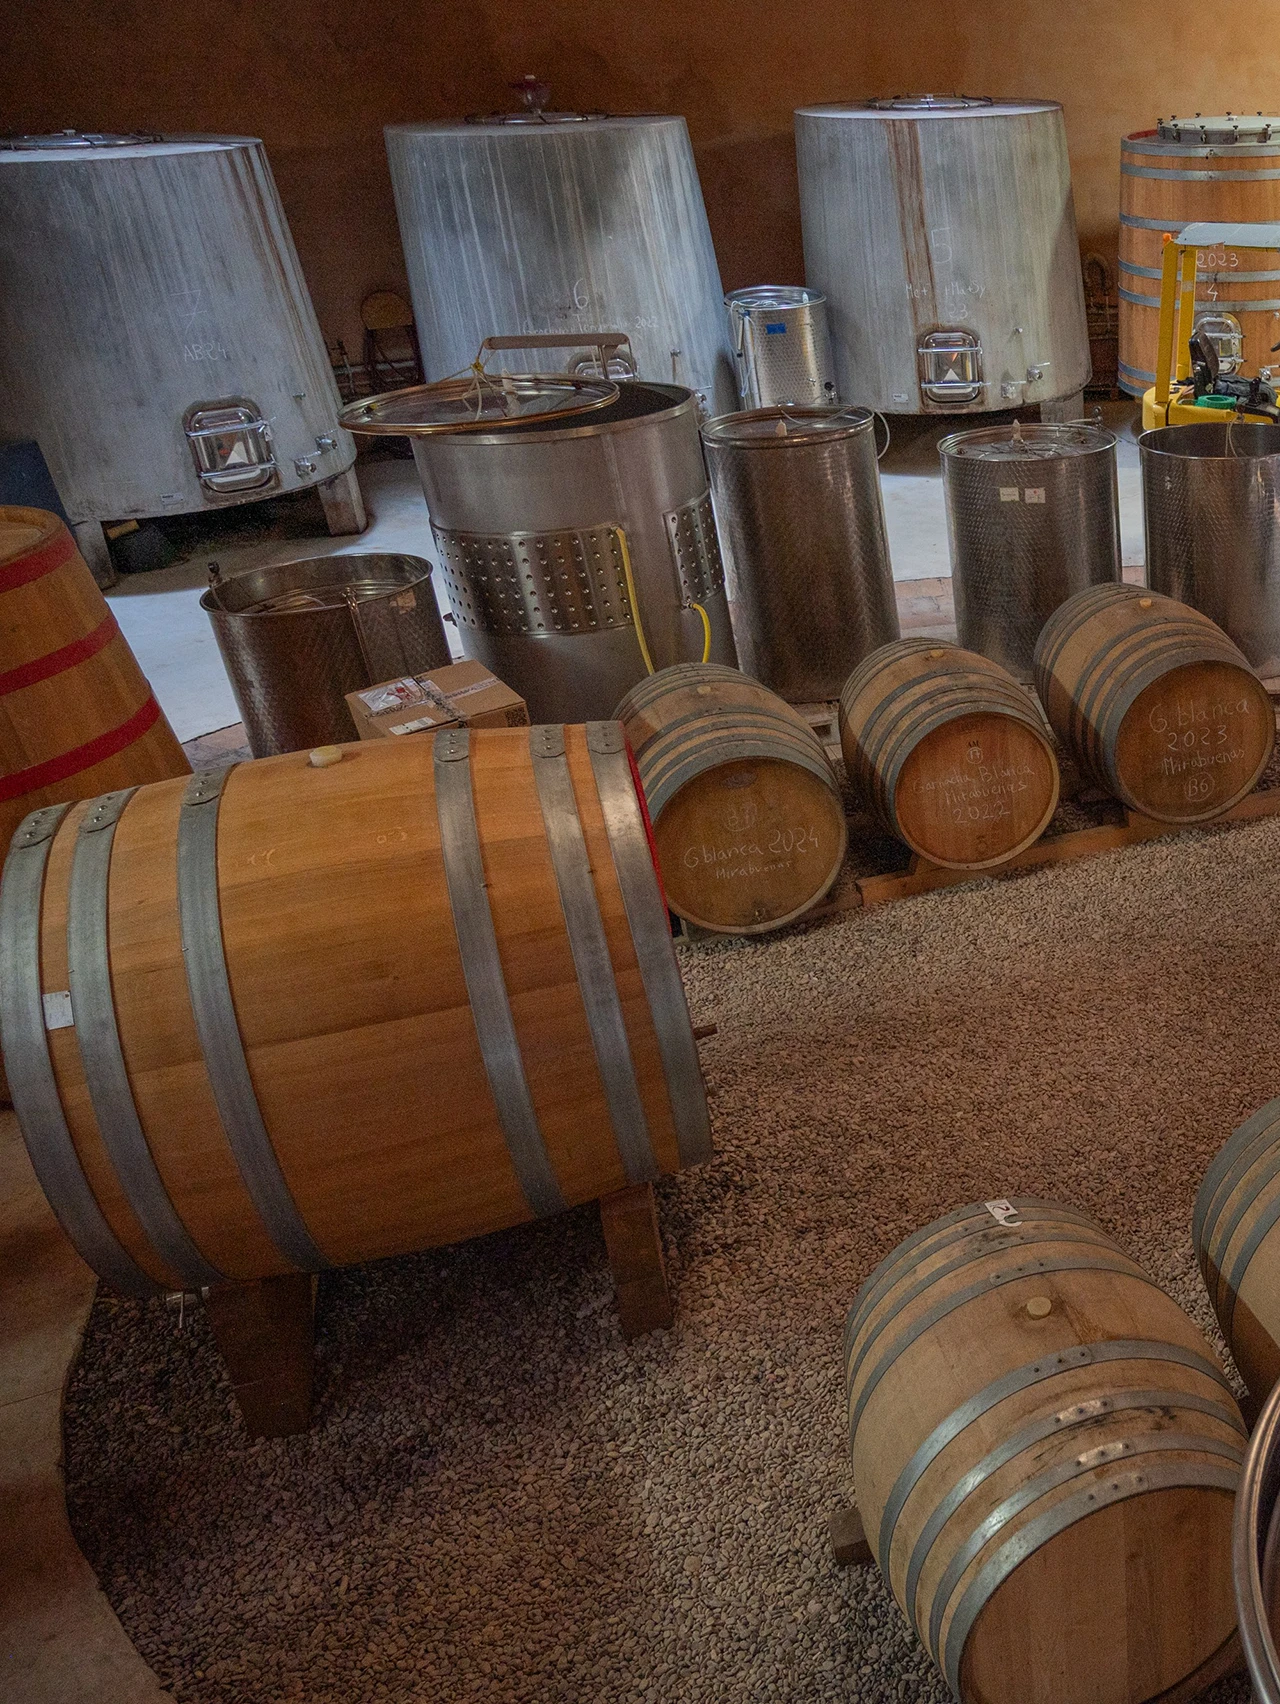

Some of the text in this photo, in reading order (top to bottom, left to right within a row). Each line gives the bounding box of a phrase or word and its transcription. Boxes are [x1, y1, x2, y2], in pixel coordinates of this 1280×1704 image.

[931, 227, 953, 264] 5
[1196, 253, 1239, 268] 2023
[573, 278, 589, 310] 6
[1207, 283, 1219, 301] 4
[169, 289, 208, 335] 7
[1167, 724, 1228, 751] 2023
[978, 765, 1035, 783] Blanca
[952, 800, 1011, 824] 2022
[768, 826, 819, 853] 2024
